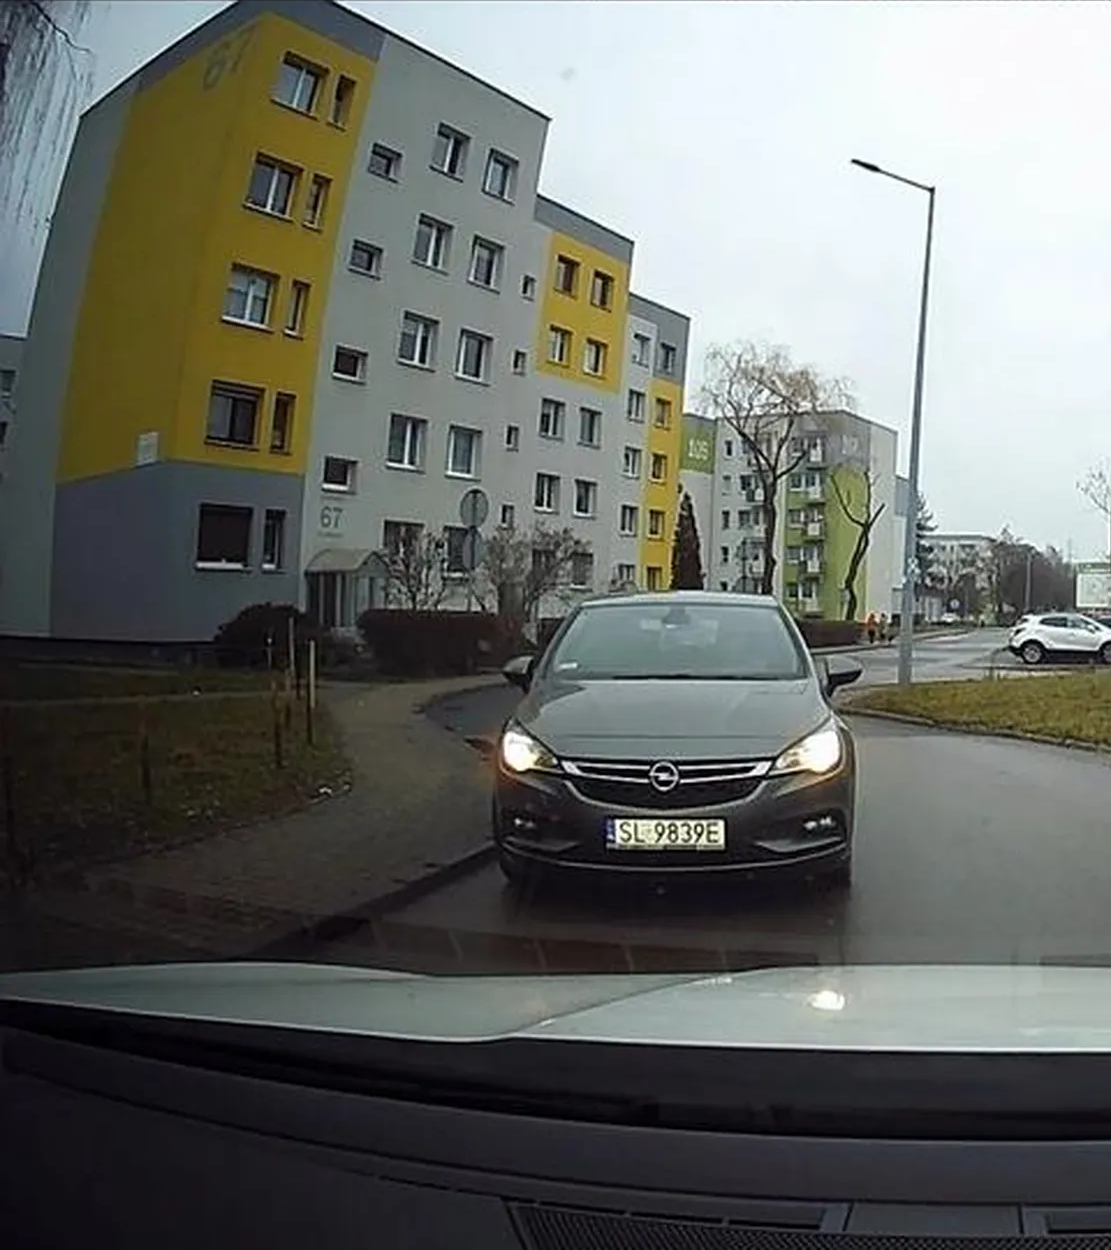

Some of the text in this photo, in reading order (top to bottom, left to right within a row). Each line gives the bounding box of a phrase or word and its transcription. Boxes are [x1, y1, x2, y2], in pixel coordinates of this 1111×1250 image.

[321, 505, 343, 528] 67
[619, 821, 719, 843] SL 9839E
